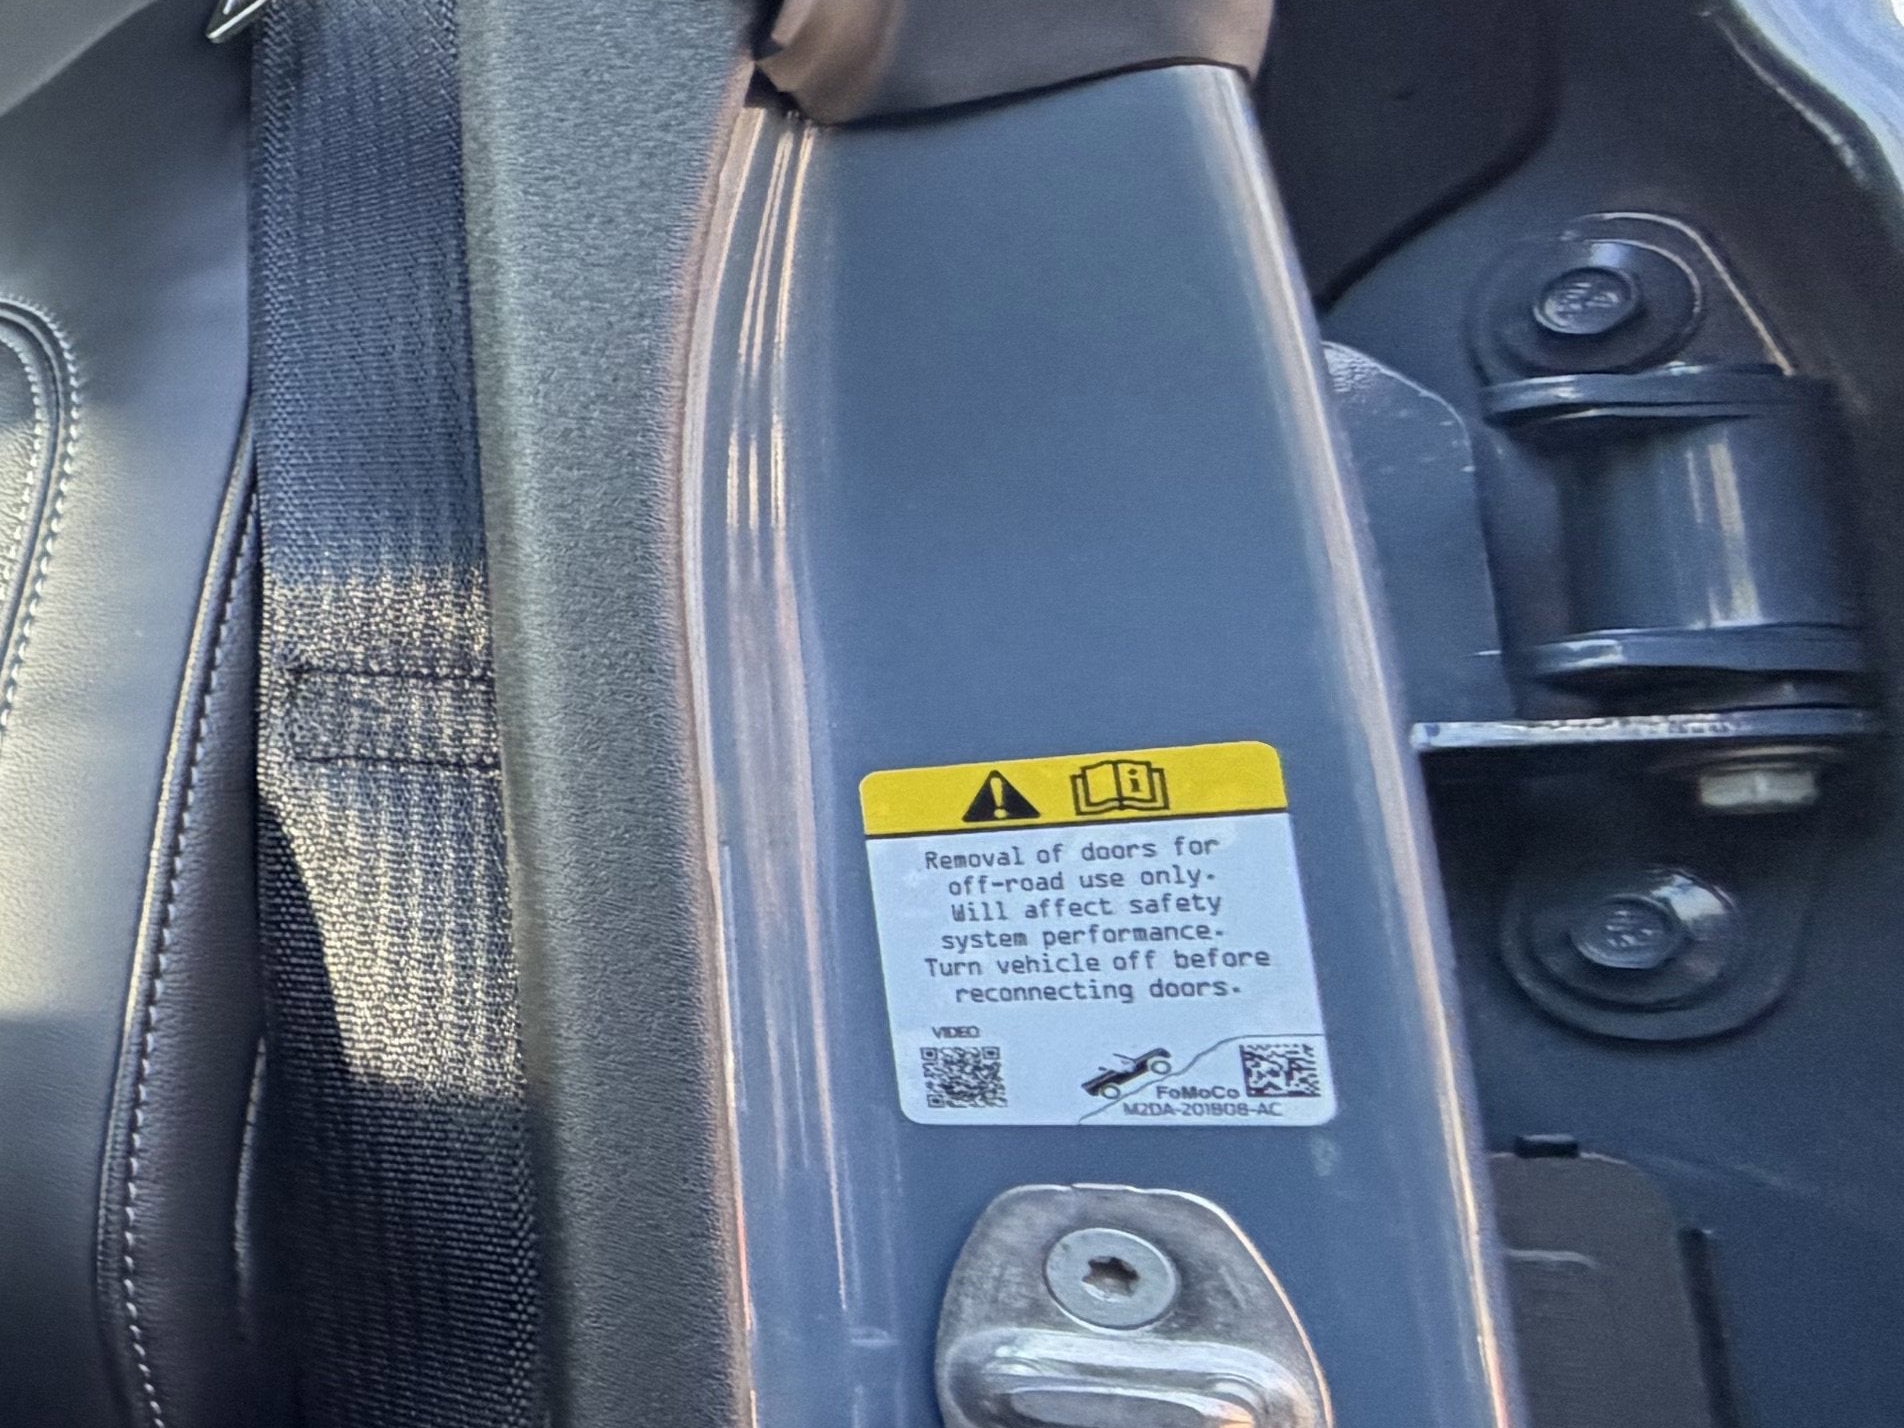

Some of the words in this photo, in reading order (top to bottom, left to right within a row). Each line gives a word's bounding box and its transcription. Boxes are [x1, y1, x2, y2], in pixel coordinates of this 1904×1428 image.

[925, 846, 1024, 869] Removal
[1036, 844, 1064, 864] of
[1081, 842, 1156, 861] doors
[1175, 836, 1219, 855] for
[949, 872, 1064, 895] off-road
[1080, 871, 1124, 888] use
[1140, 865, 1215, 889] only.
[952, 903, 1008, 922] Will
[1025, 898, 1112, 920] affect
[1130, 893, 1221, 916] safety
[941, 929, 1027, 953] system
[1043, 925, 1224, 949] performance.
[925, 958, 982, 977] Turn
[997, 954, 1100, 974] vehicle
[1113, 950, 1156, 970] off
[1175, 948, 1271, 968] before
[956, 981, 1133, 1004] reconnecting
[1150, 979, 1240, 998] doors.
[1156, 1086, 1240, 1100] FoMoCo
